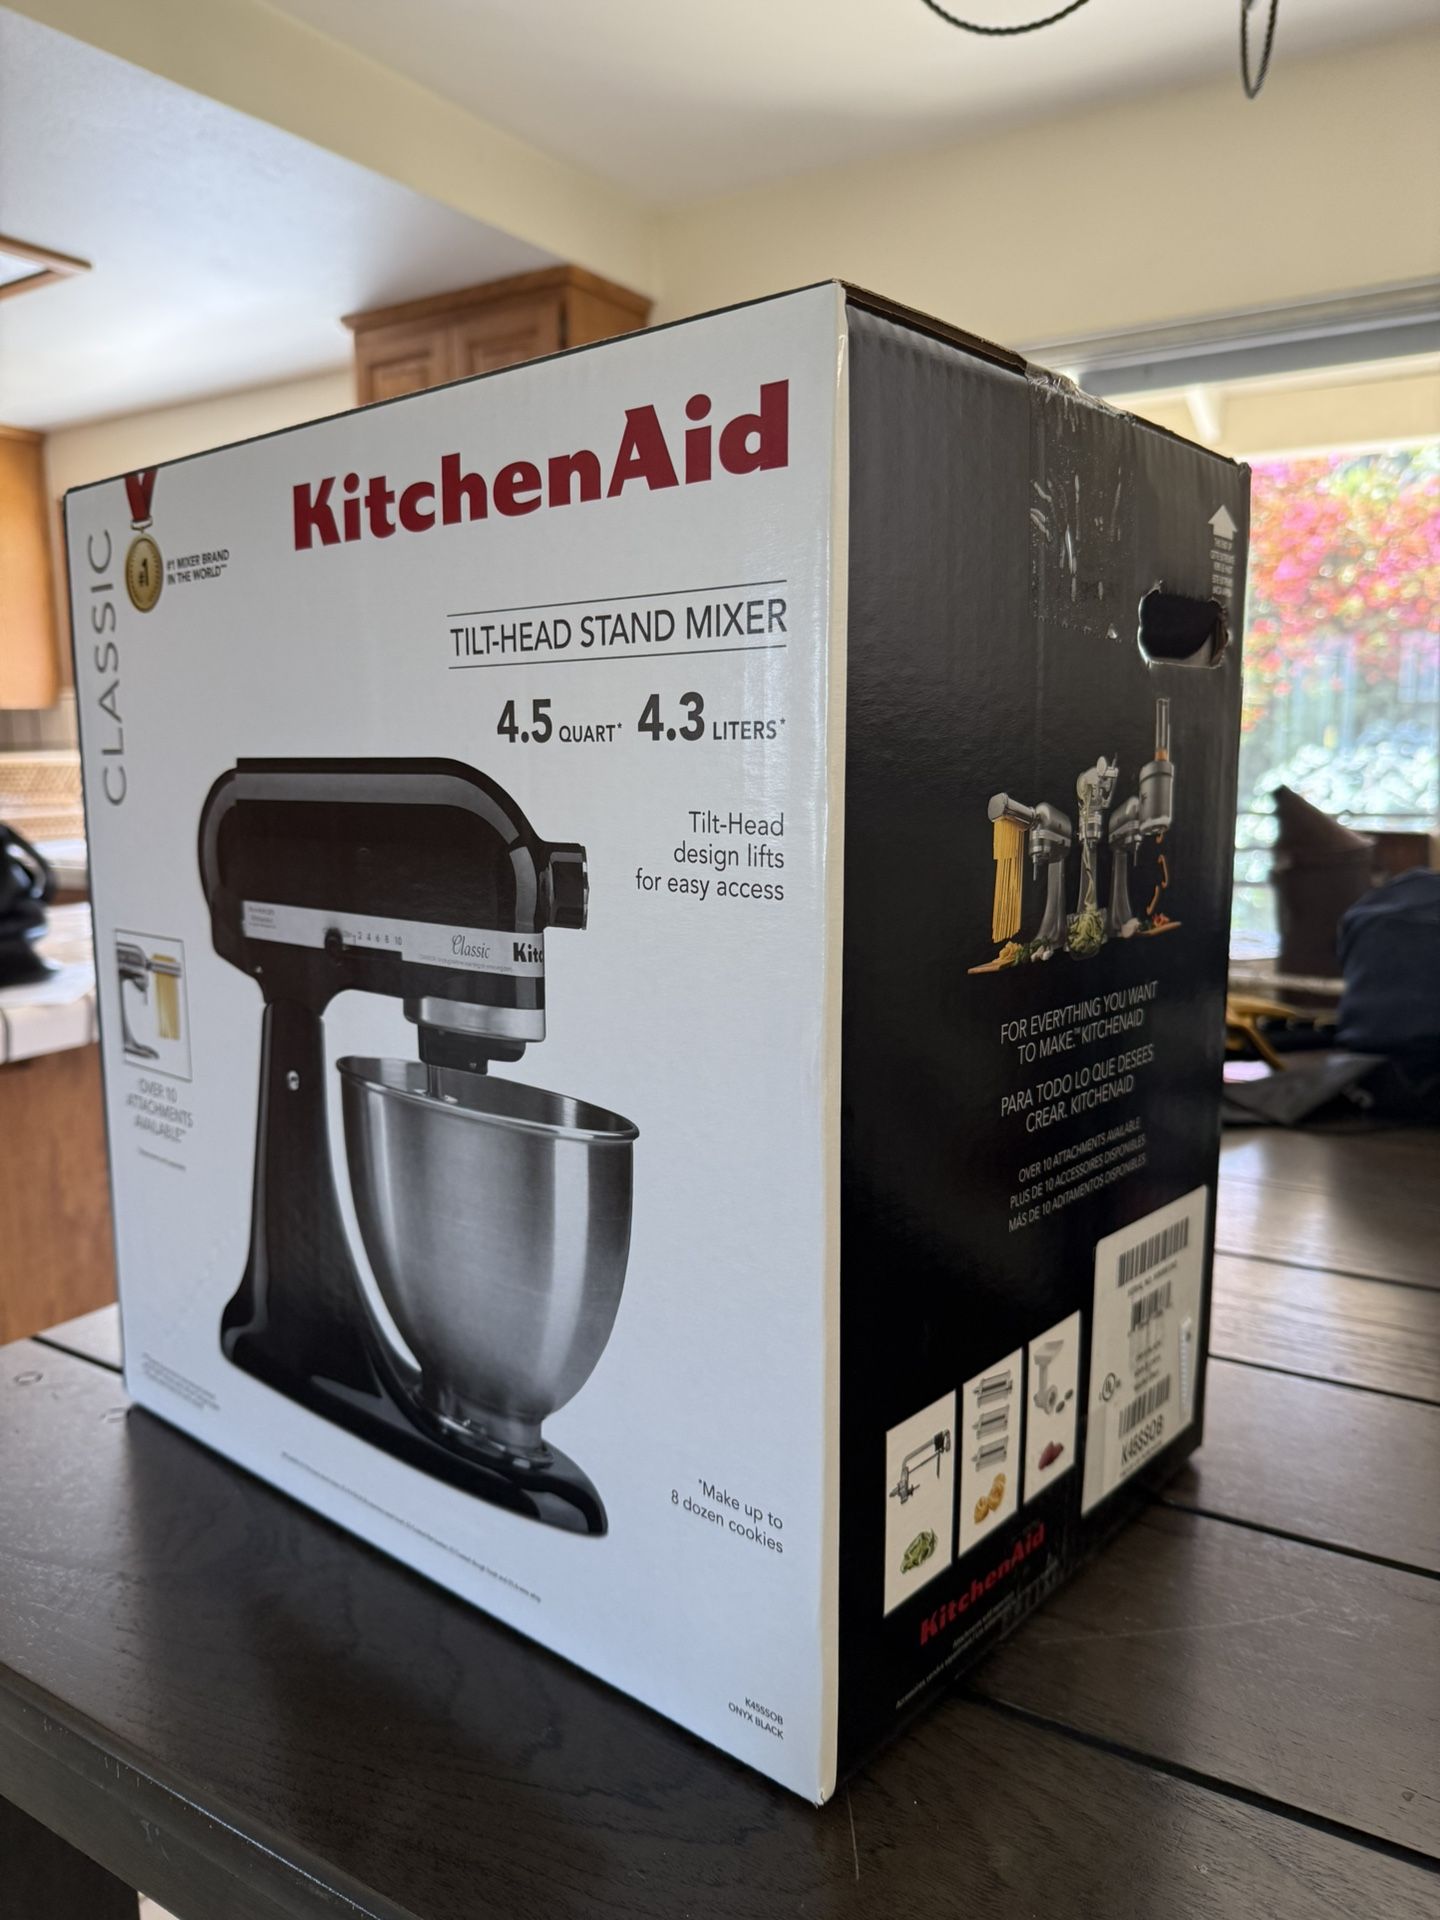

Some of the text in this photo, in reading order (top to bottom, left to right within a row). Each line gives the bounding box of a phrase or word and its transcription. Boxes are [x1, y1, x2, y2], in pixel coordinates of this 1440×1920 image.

[293, 379, 789, 551] KitchenAid
[177, 571, 191, 583] THE
[202, 549, 230, 565] BRAND
[450, 598, 787, 656] TILT-HEAD STAND MIXER
[88, 528, 127, 806] CLASSIC
[497, 698, 553, 743] 4.5
[637, 691, 705, 741] 4.3
[688, 810, 784, 836] Tilt-Head
[673, 840, 785, 872] design lifts
[636, 867, 785, 901] for easy access
[452, 934, 490, 959] Classic
[1000, 979, 1158, 1045] FOR EVERYTHING YOU WANT
[1017, 1041, 1036, 1065] TO
[1081, 1008, 1144, 1045] KITCHENAID
[1001, 1043, 1155, 1118] PARA TODO LO QUE DESEES
[1025, 1074, 1135, 1134] CREAR. KITCHENAID
[1018, 1116, 1141, 1183] OVER 10 ATTACHMENTS AVAILABLE
[1010, 1188, 1031, 1210] PLUS
[1031, 1182, 1043, 1200] DE
[1045, 1177, 1054, 1192] 10
[1028, 1205, 1040, 1223] DE
[1042, 1200, 1051, 1216] 10
[671, 1488, 784, 1554] 8 dozen cookies
[744, 1504, 763, 1524] up
[768, 1511, 783, 1530] to
[919, 1521, 1046, 1648] KitchenAid
[728, 1701, 784, 1741] ONYX BLACK
